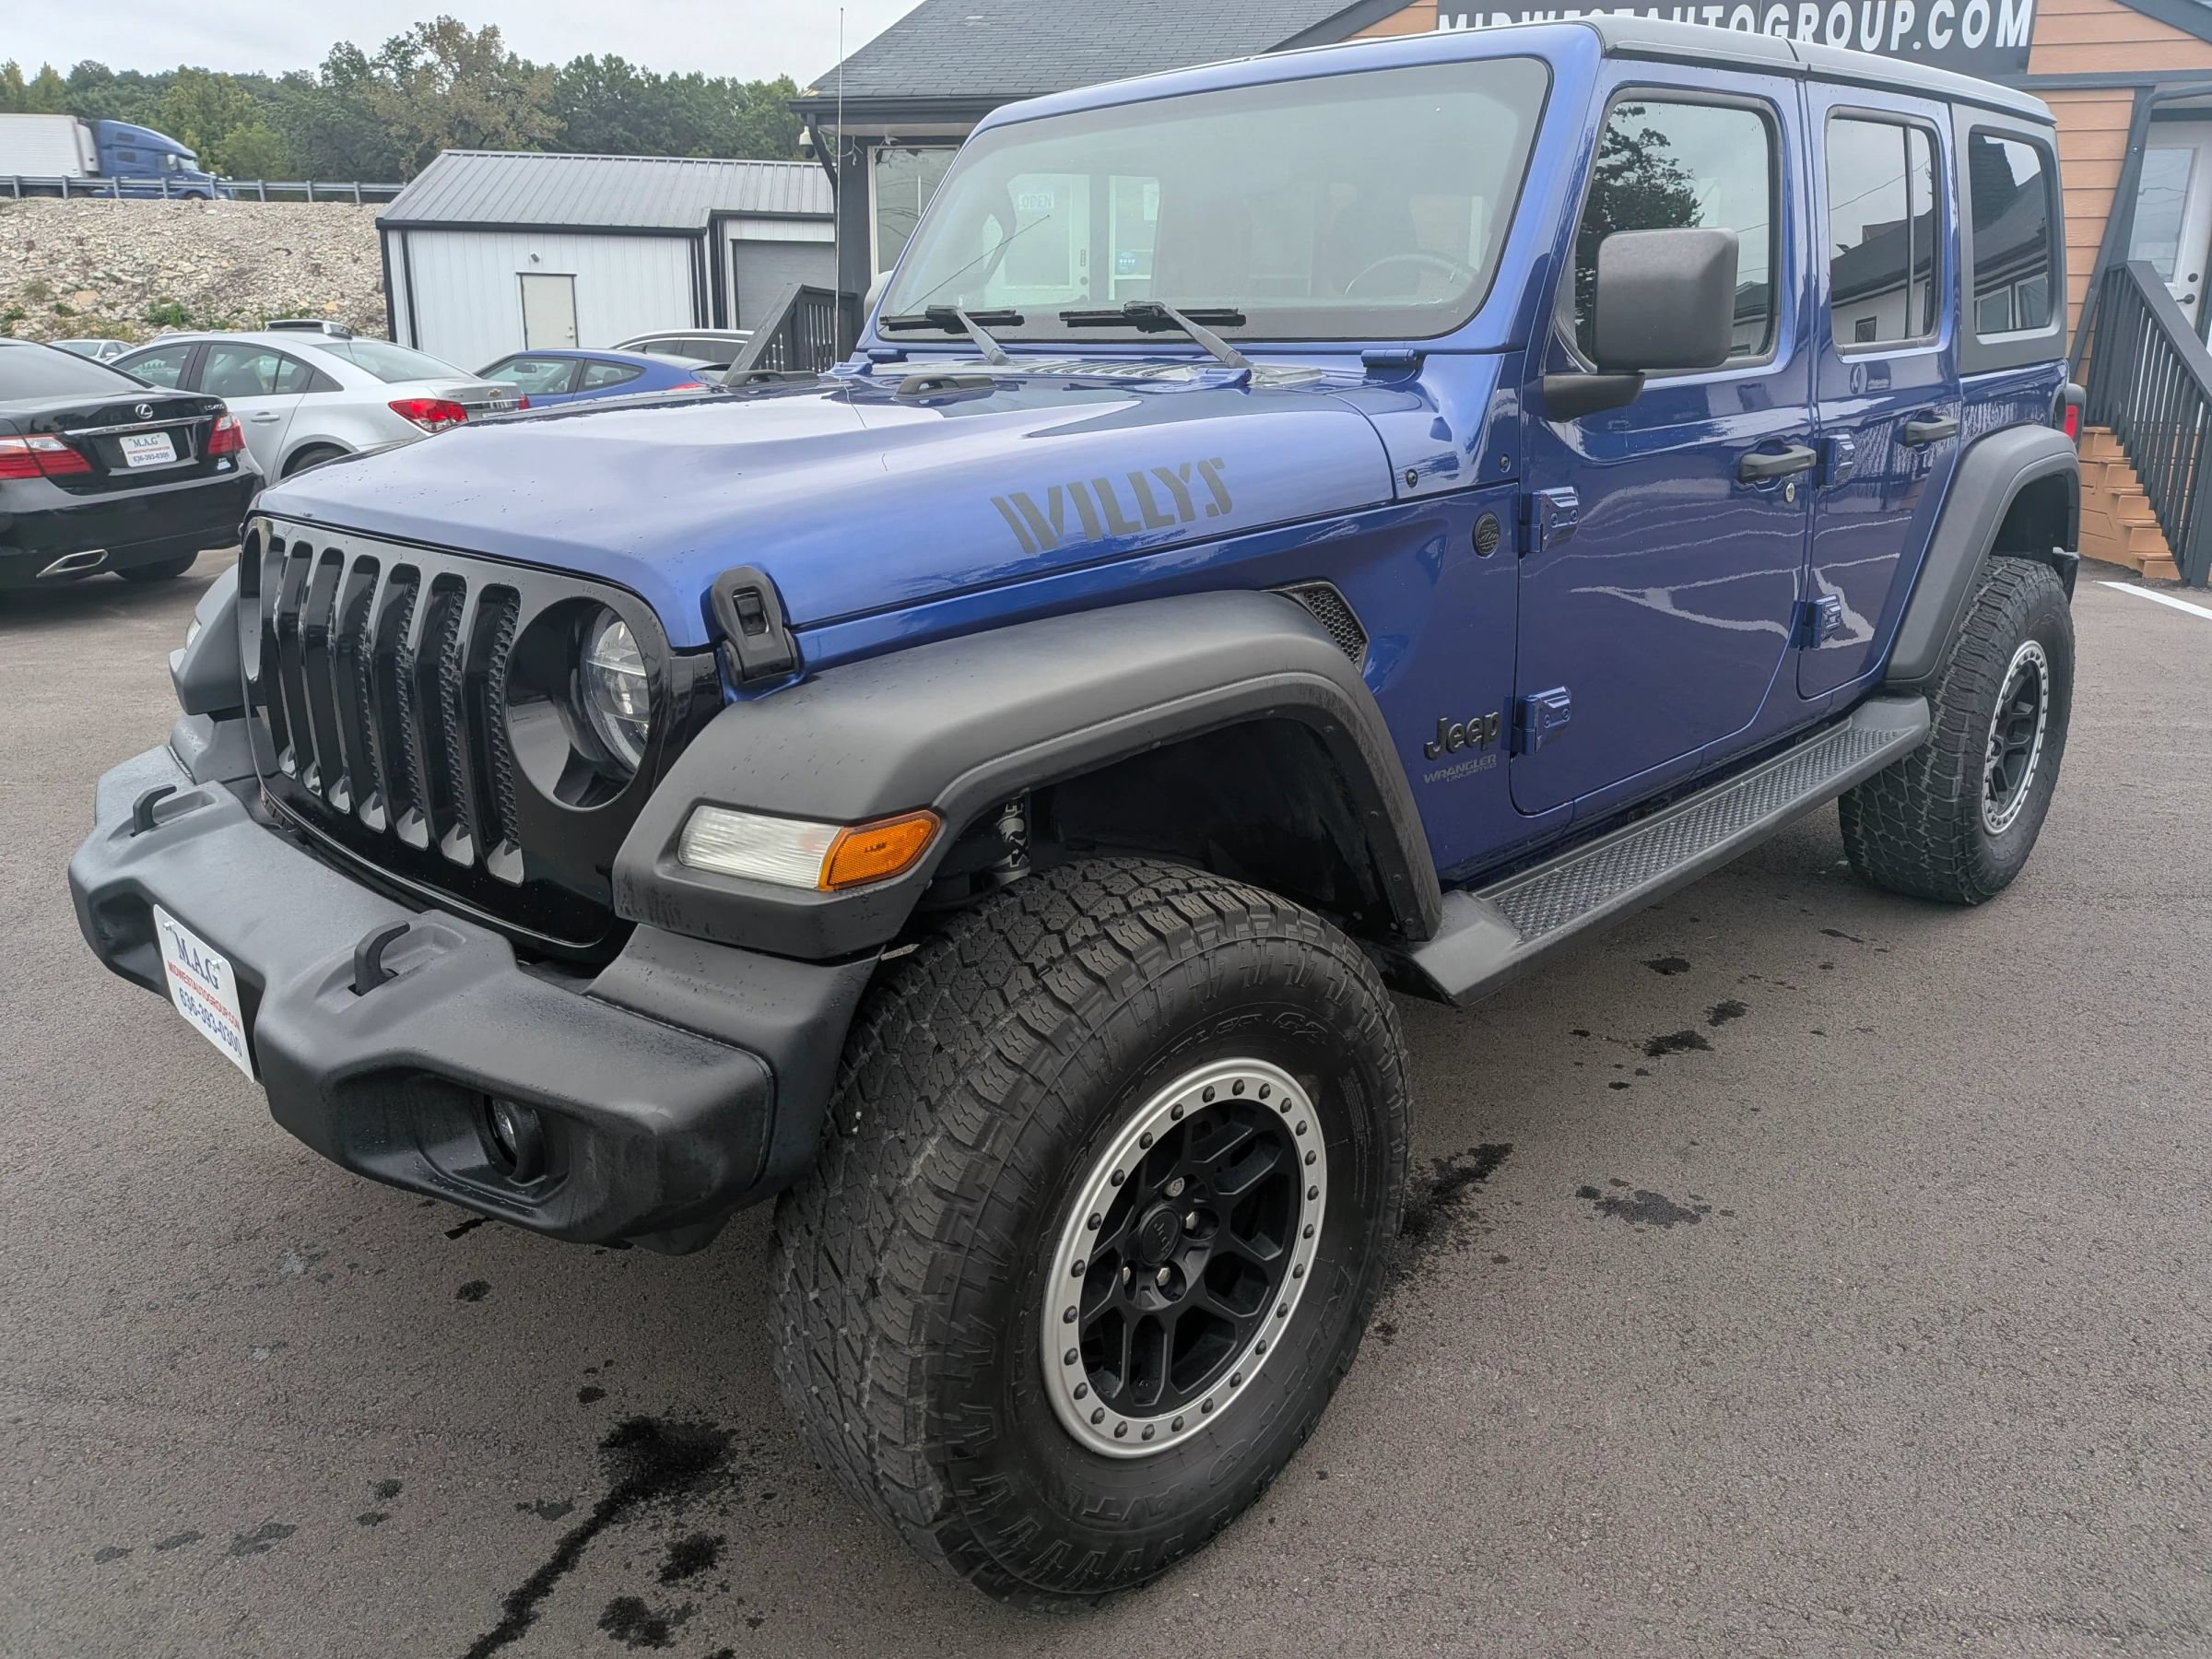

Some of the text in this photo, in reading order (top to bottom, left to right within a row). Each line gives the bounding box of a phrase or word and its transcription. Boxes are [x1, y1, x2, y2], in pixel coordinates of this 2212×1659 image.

[1439, 0, 2034, 51] TOGROUP.COM
[1021, 193, 1052, 208] OPEN
[990, 456, 1233, 554] WILLYS
[1424, 712, 1500, 760] Jeep
[1423, 754, 1497, 783] WRANGLER
[179, 986, 243, 1058] 636-393-0300
